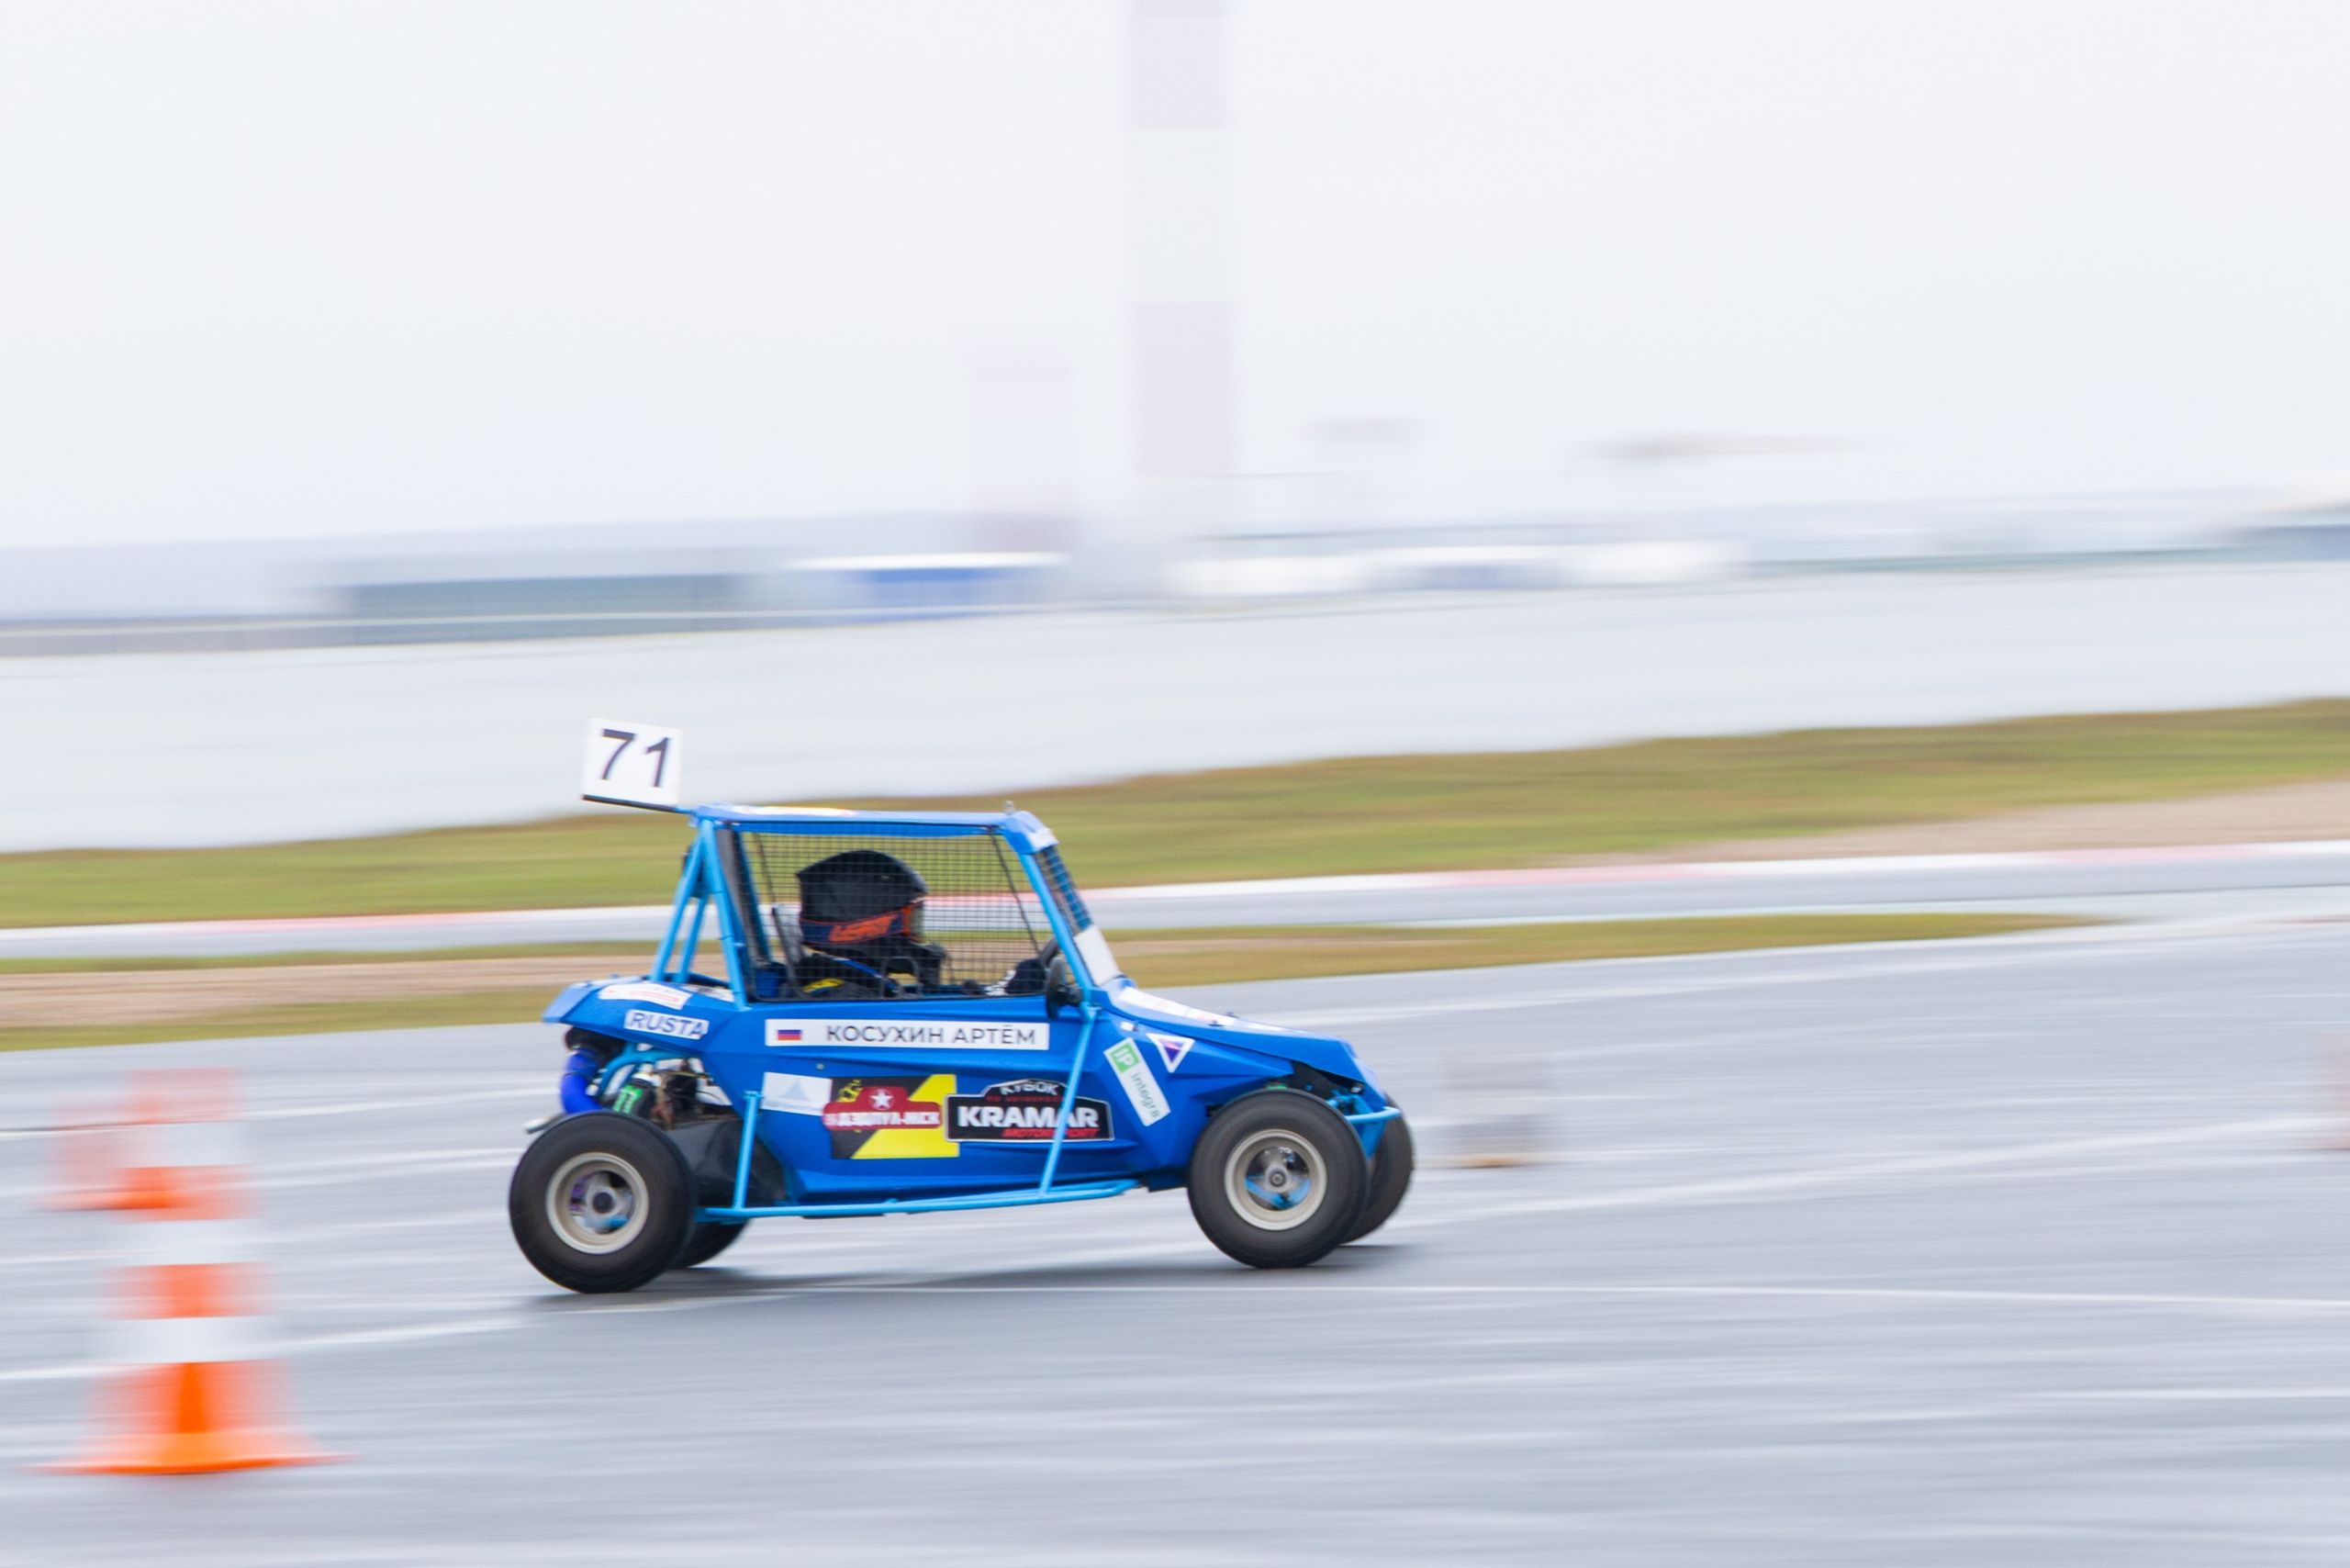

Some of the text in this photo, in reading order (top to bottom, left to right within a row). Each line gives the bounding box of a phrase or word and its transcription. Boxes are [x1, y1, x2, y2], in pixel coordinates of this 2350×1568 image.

[601, 728, 671, 788] 71
[630, 1012, 703, 1036] RUSTA
[827, 1025, 1036, 1045] КОСУХИН АРТЁМ
[1130, 1071, 1161, 1119] integra
[957, 1106, 1100, 1128] KRAMAR
